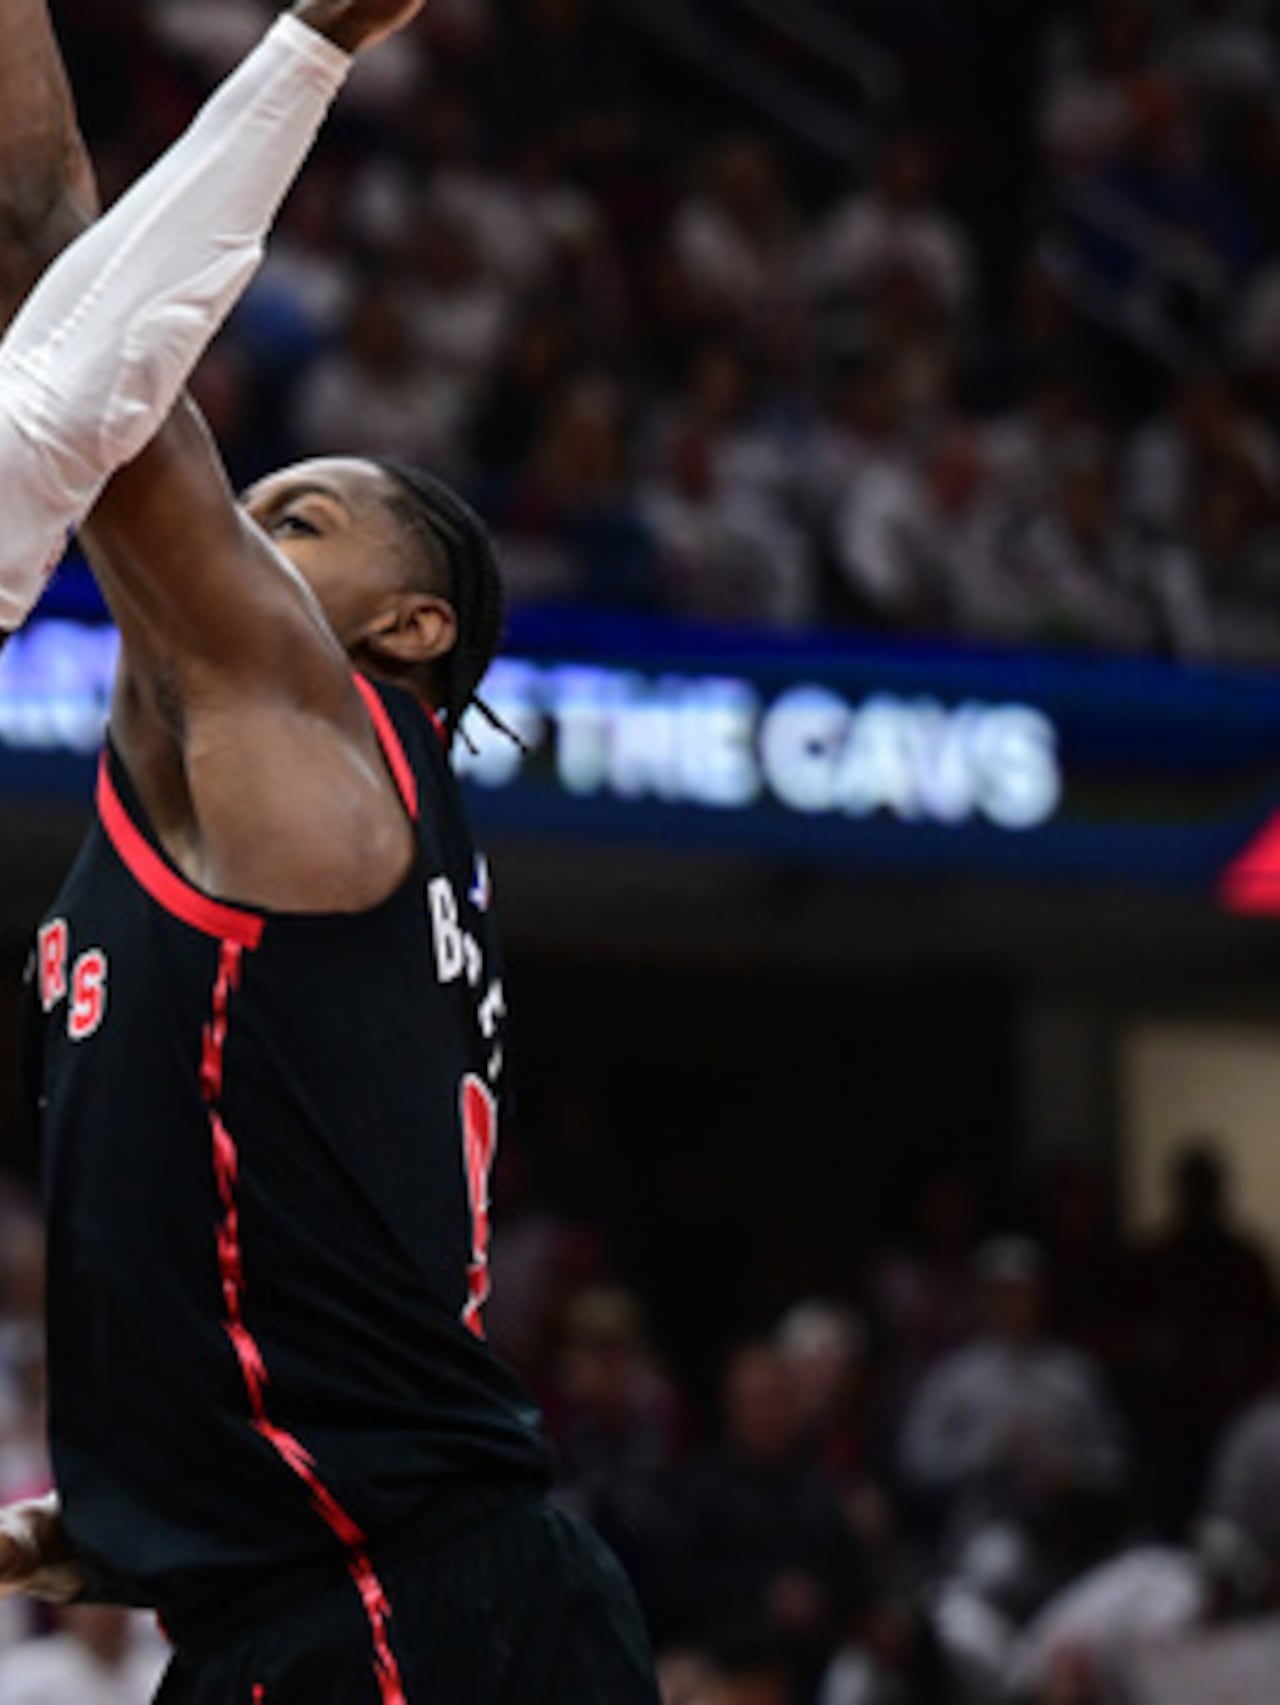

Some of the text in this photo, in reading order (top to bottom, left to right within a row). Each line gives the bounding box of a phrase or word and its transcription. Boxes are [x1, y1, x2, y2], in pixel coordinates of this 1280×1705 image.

[555, 664, 760, 807] THE
[760, 685, 1062, 829] CAVS
[23, 916, 109, 1039] RS
